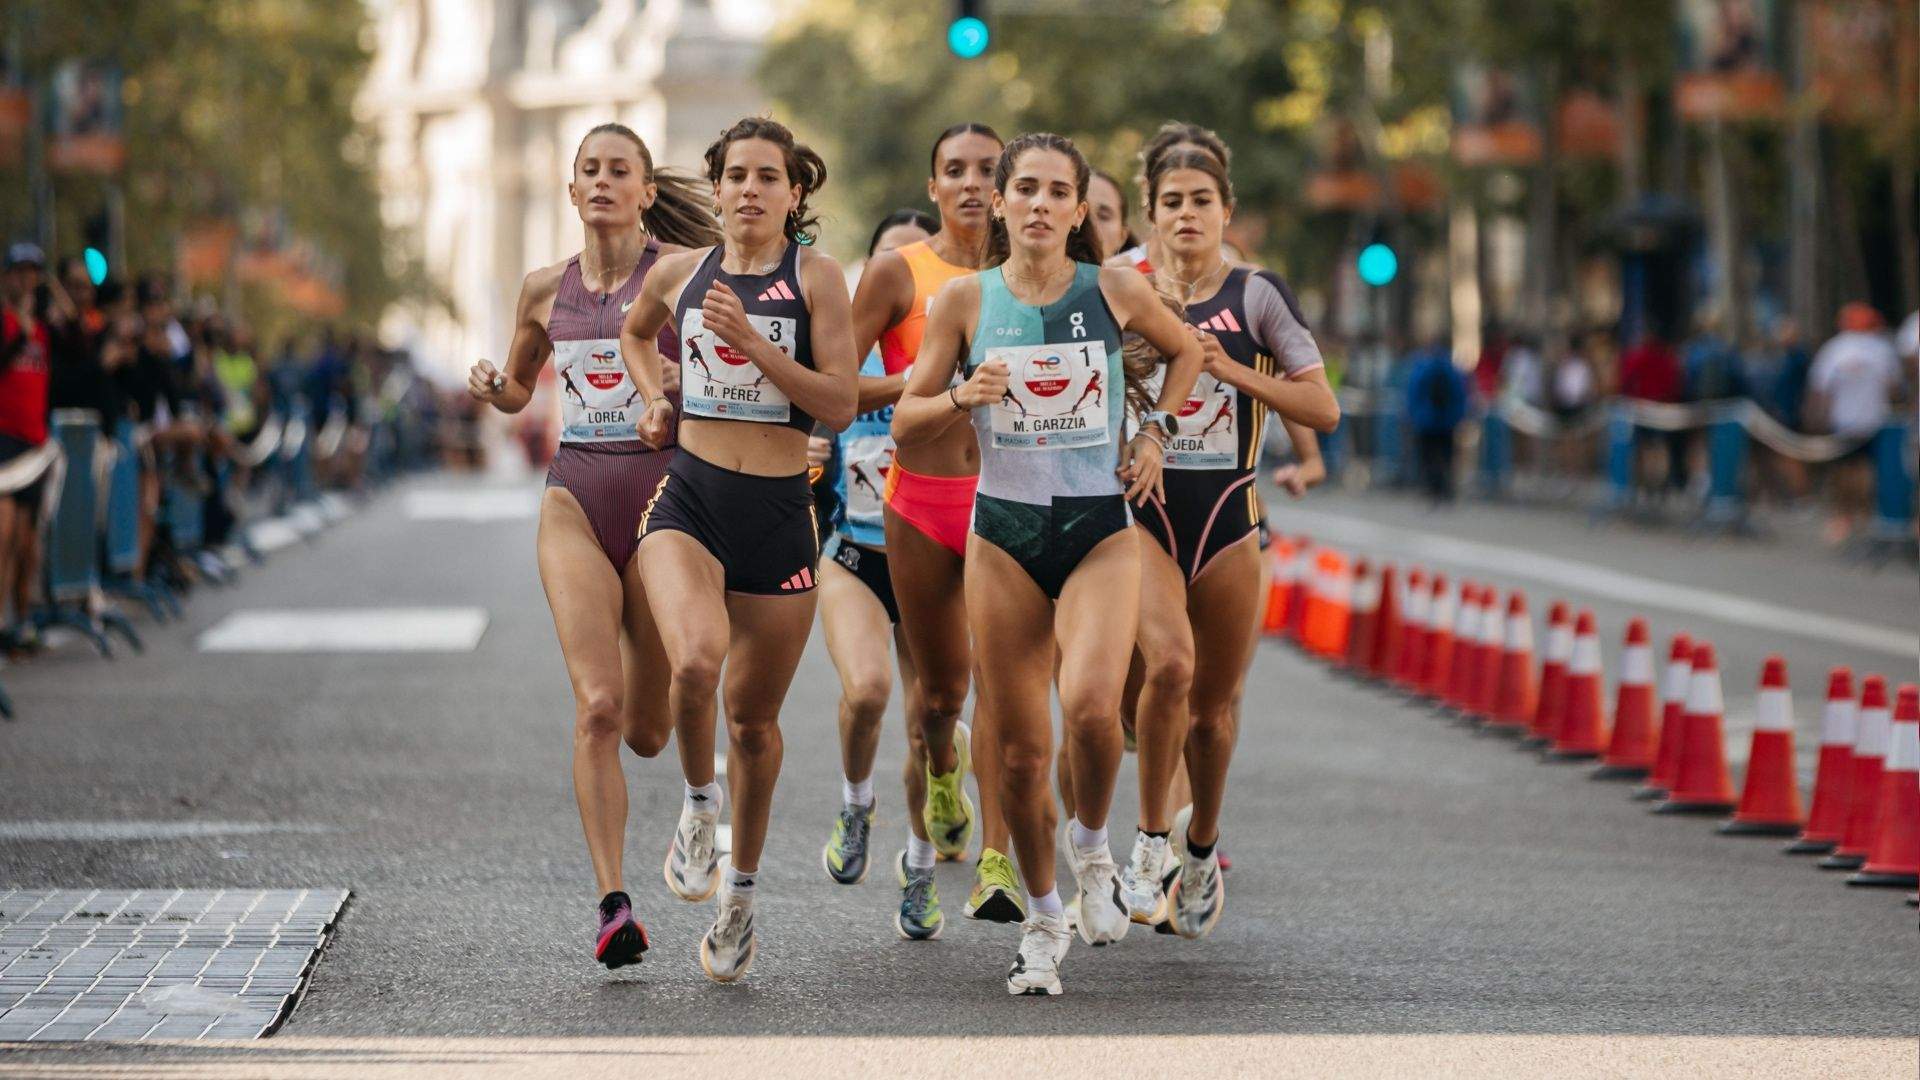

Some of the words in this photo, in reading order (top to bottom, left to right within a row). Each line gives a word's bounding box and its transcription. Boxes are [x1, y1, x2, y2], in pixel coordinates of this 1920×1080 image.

[769, 320, 782, 342] 3
[996, 327, 1023, 336] OAC
[1080, 346, 1090, 367] 1
[703, 385, 718, 399] M.
[722, 385, 761, 403] PÉREZ
[588, 411, 625, 424] LOREA
[1014, 420, 1029, 432] M.
[1034, 417, 1087, 432] GARZZIA
